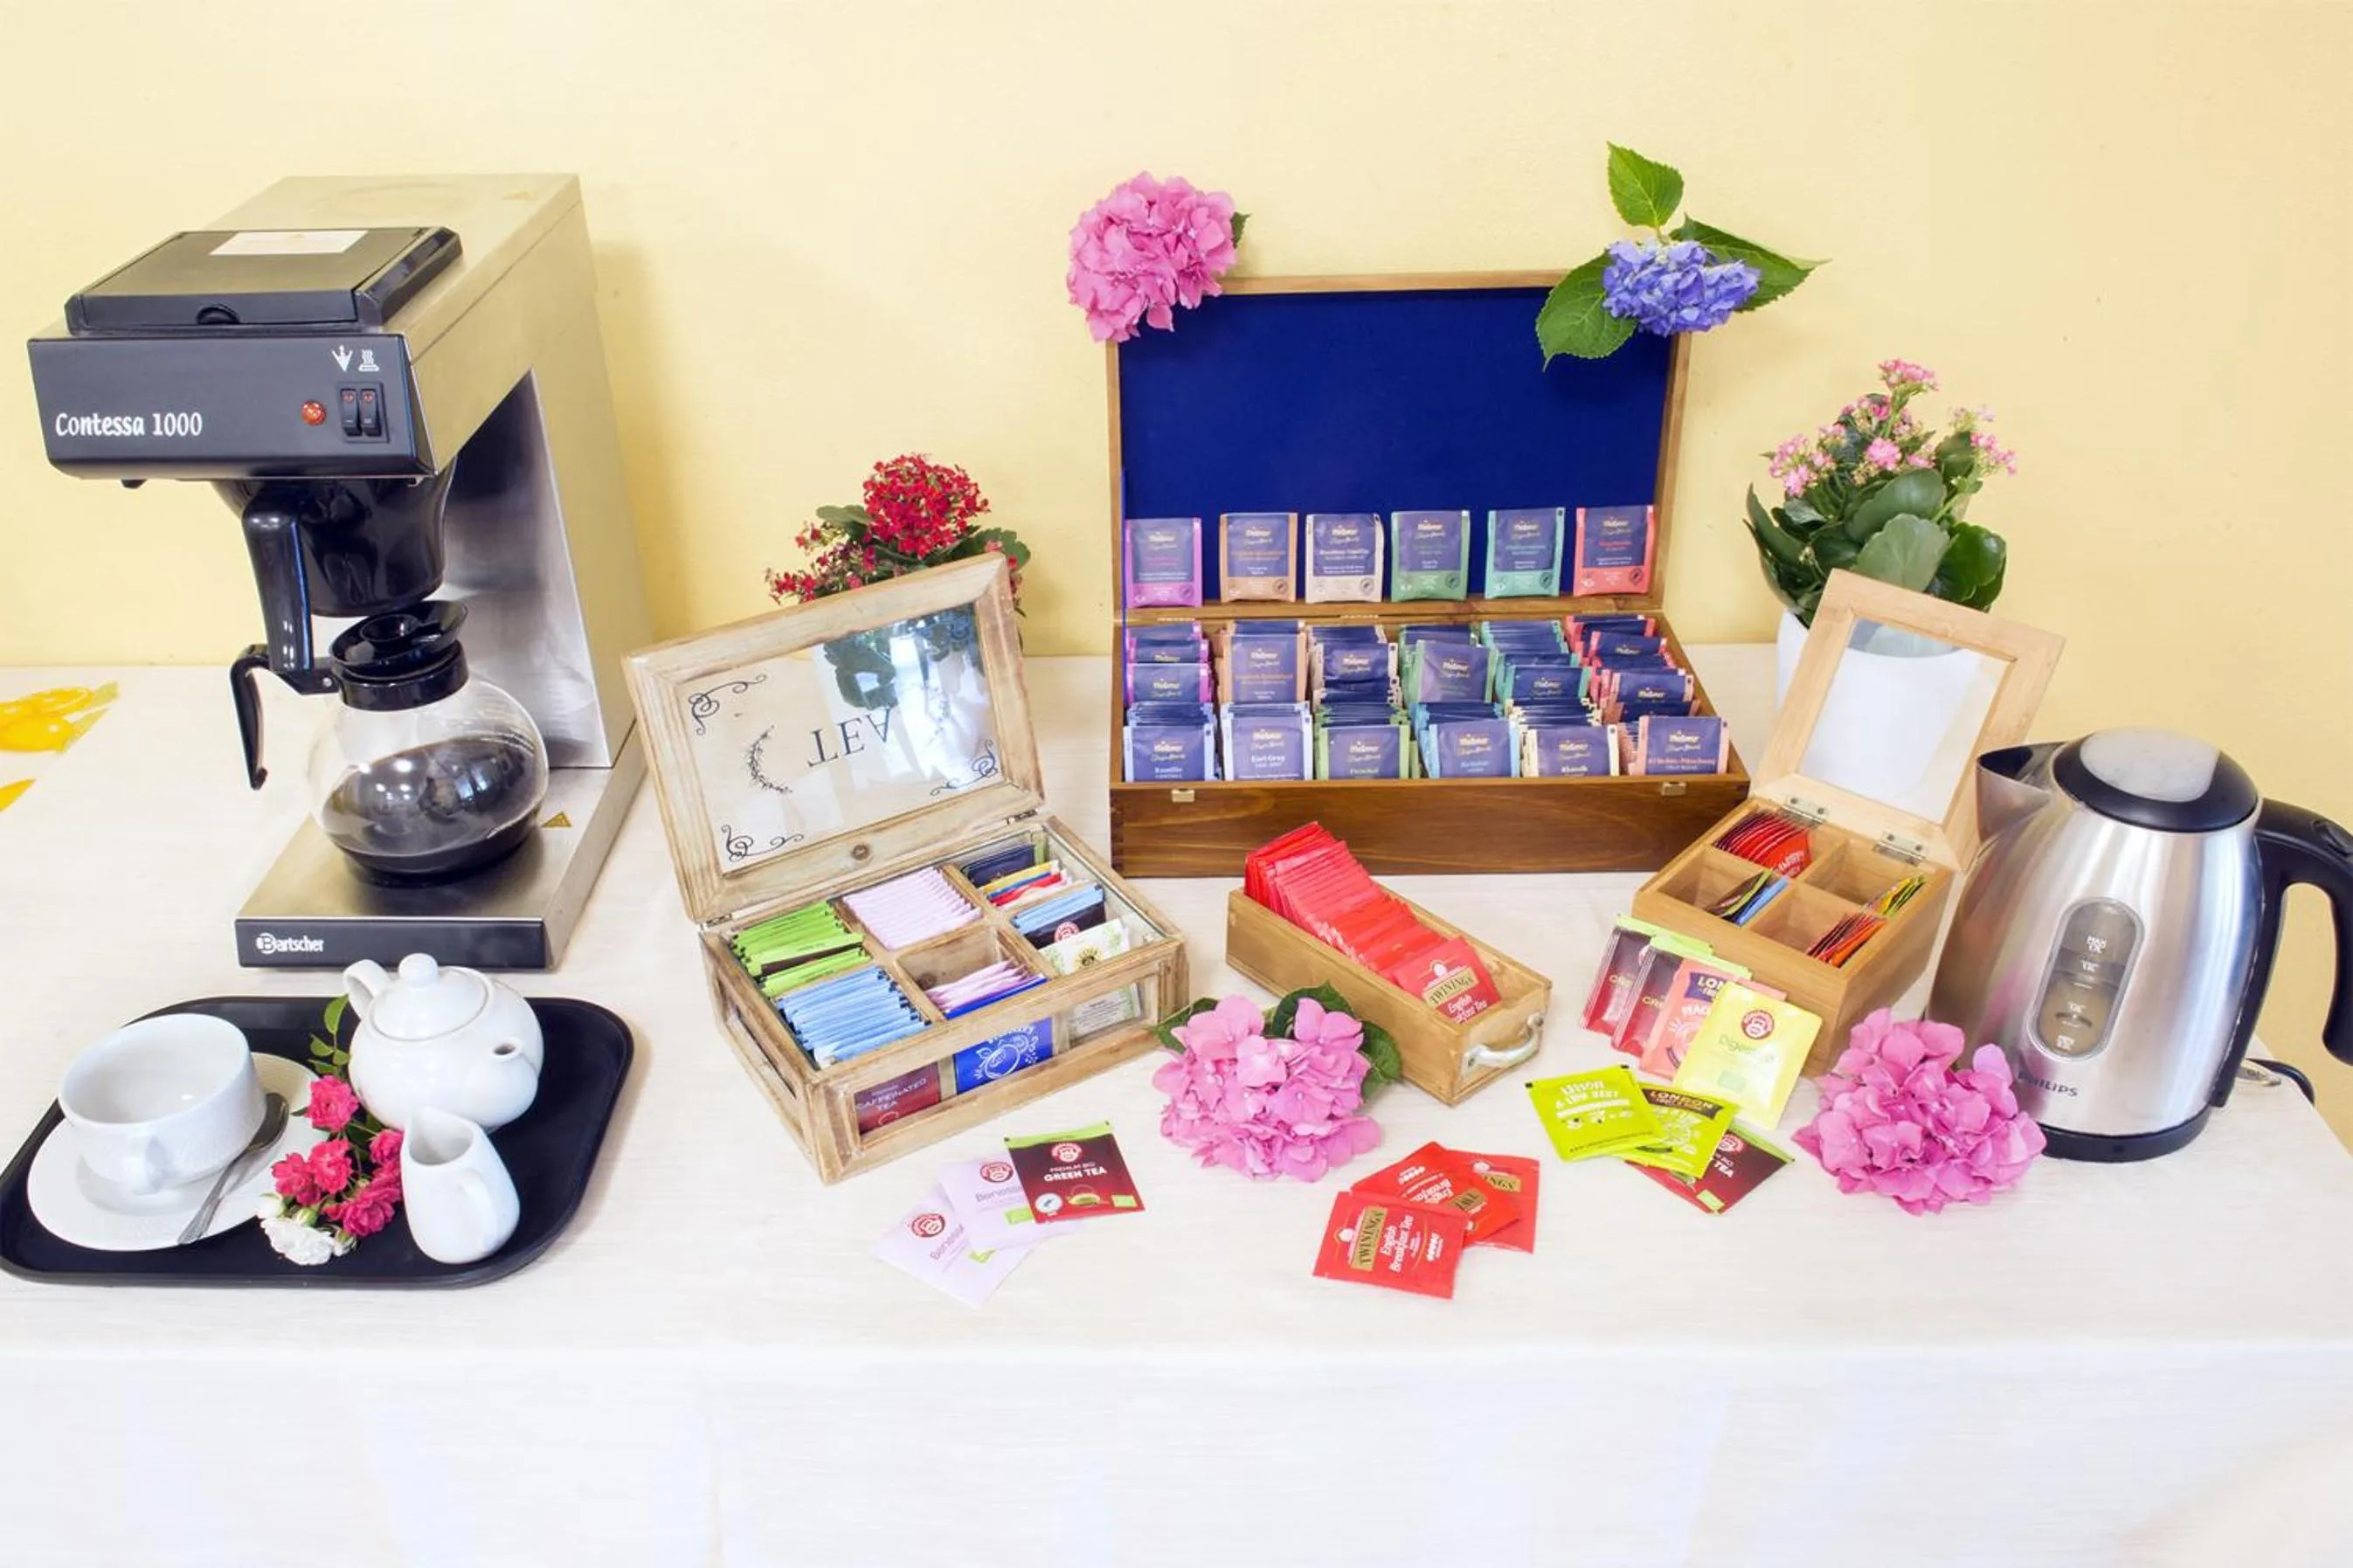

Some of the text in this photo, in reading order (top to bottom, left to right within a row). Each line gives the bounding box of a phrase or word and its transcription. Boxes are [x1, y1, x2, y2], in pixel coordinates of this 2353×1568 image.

[55, 412, 203, 437] Contessa 1000
[806, 708, 892, 768] TEA
[255, 932, 324, 955] Bartscher
[1428, 973, 1474, 1005] TWININGS
[2017, 1071, 2079, 1097] PHILIPS
[1650, 1090, 1713, 1109] LONDON
[1044, 1167, 1107, 1182] GREEN TEA
[1359, 1211, 1385, 1265] TWININGS
